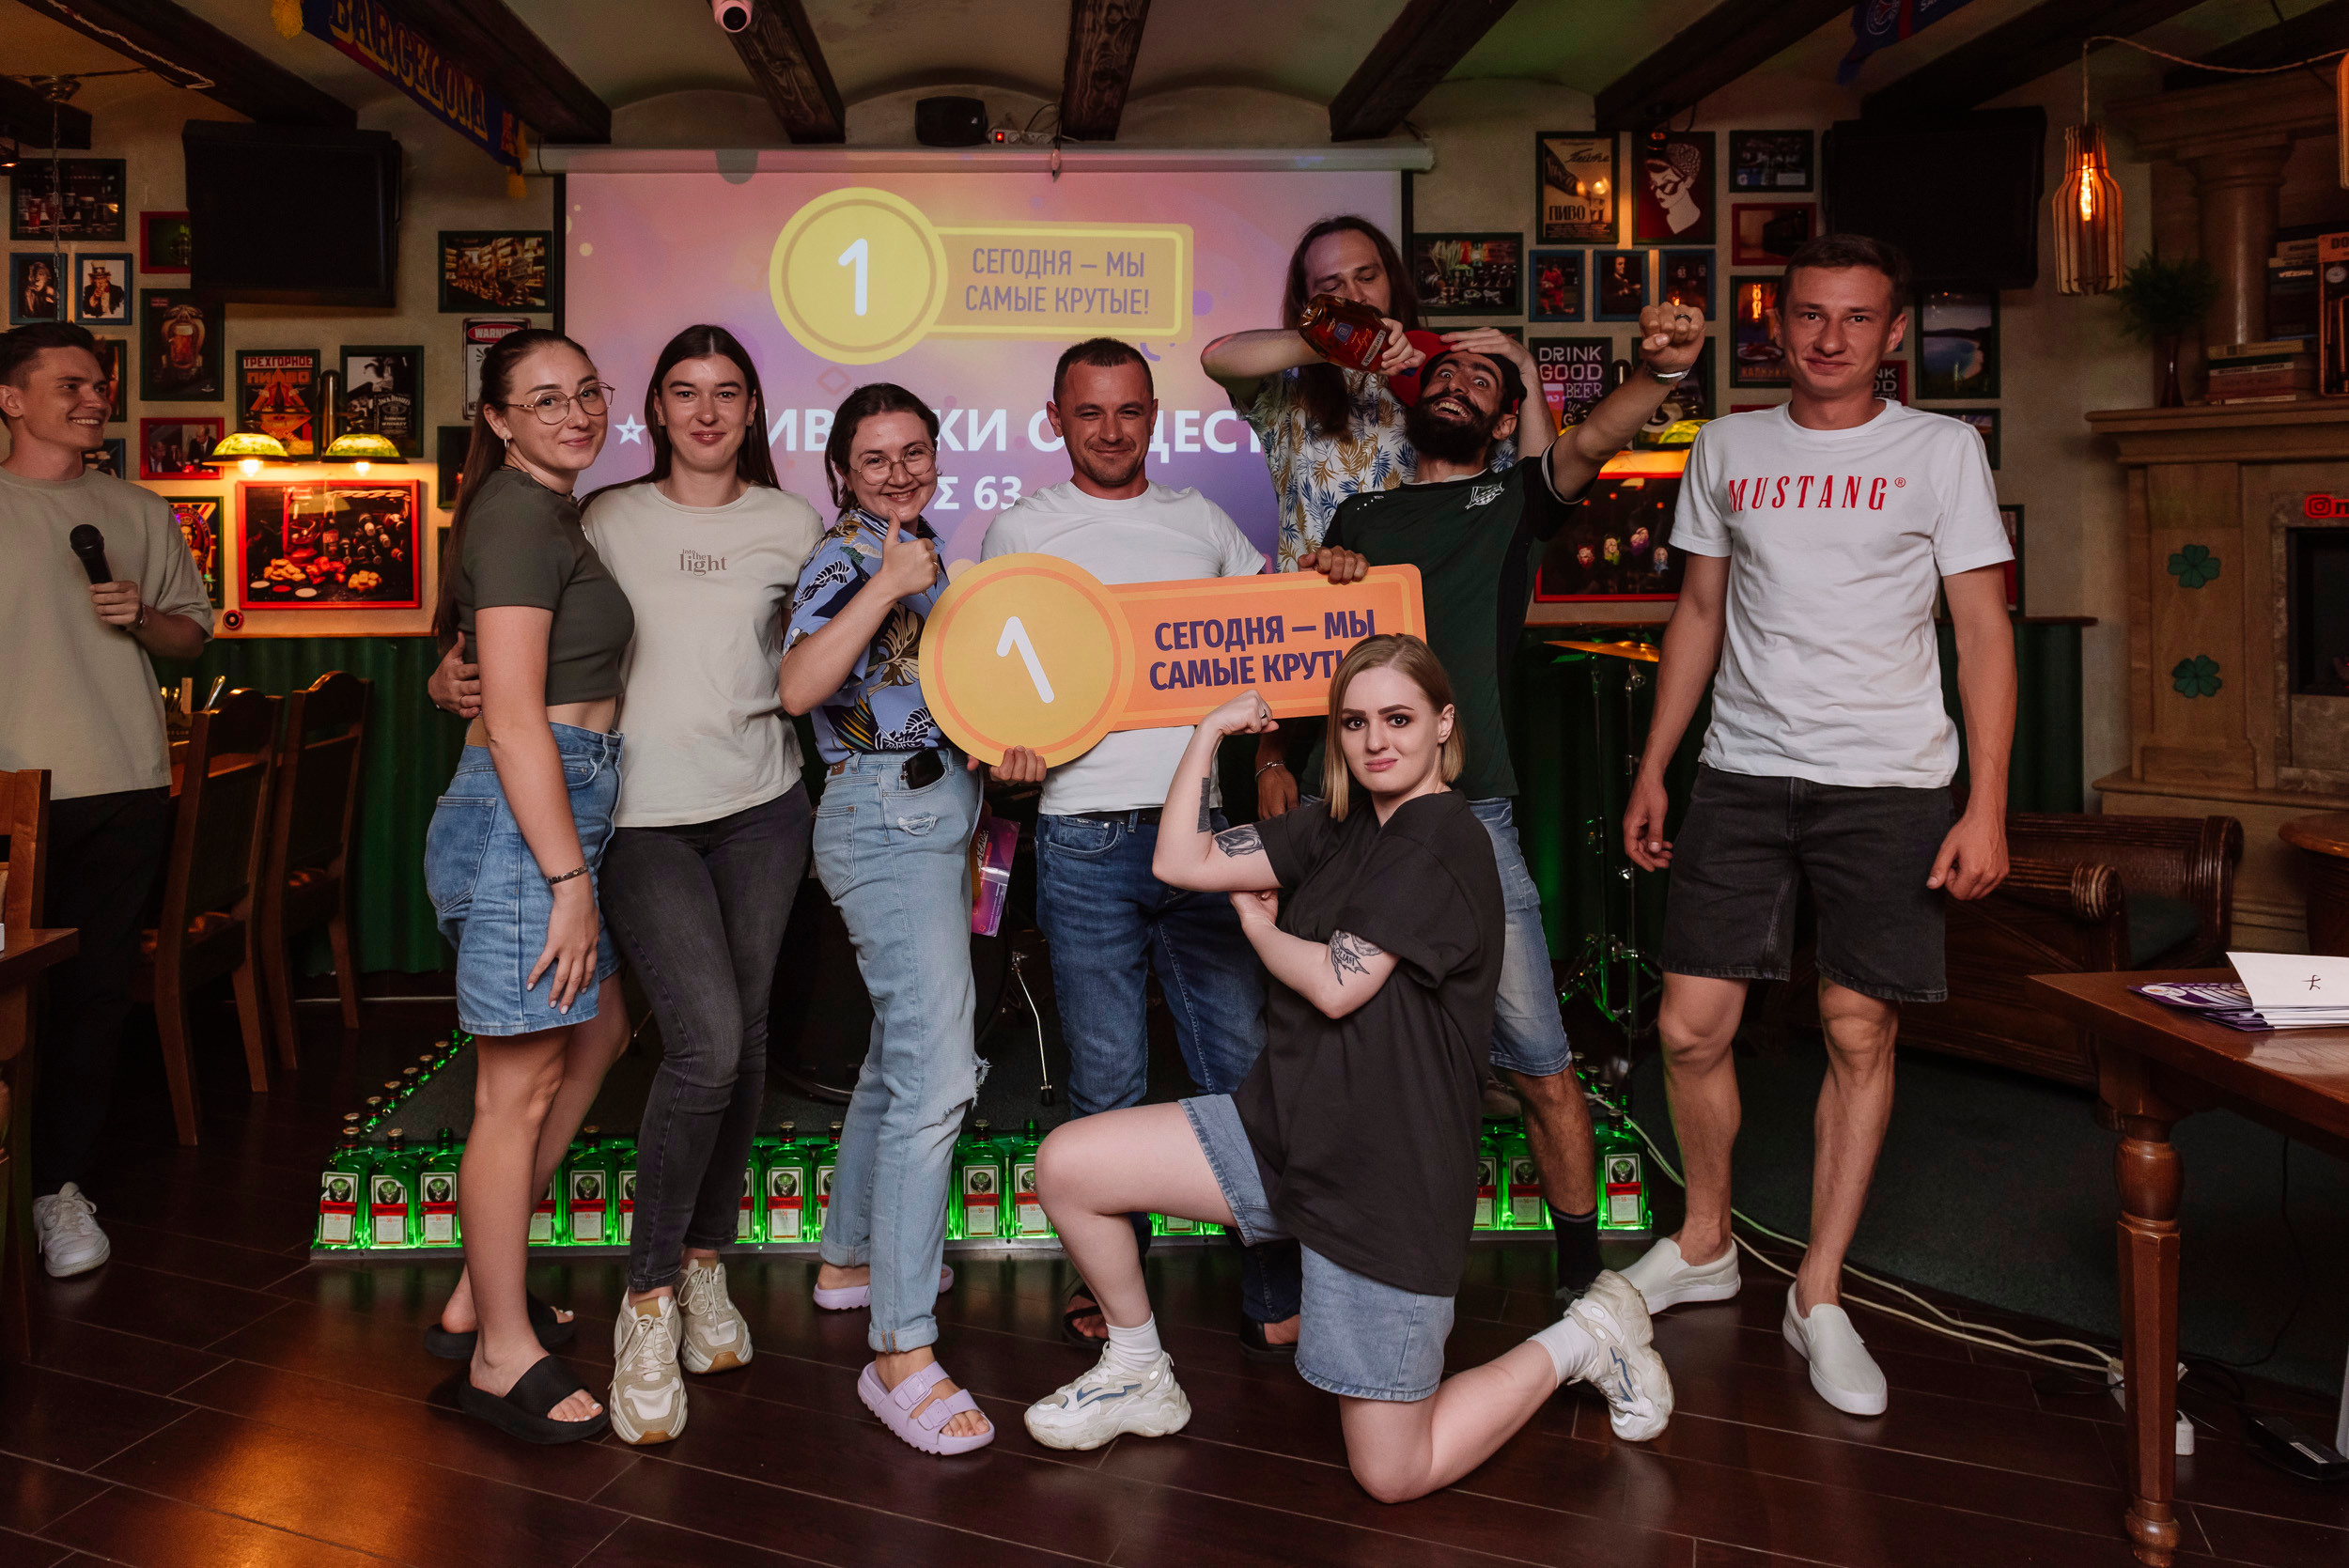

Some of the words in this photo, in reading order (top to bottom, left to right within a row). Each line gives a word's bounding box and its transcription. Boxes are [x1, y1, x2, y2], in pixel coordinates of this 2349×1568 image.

[329, 0, 489, 142] BARCELONA
[1548, 205, 1586, 222] ПИВО
[838, 237, 867, 317] 1
[972, 247, 1071, 281] СЕГОДНЯ
[1106, 251, 1144, 279] МЫ
[965, 285, 1047, 313] САМЫЕ
[1054, 287, 1148, 315] КРУТЫЕ!
[244, 356, 313, 368] ТРЕХГОРНОЕ
[1538, 346, 1602, 362] DRINK
[1539, 364, 1603, 381] GOOD
[1565, 382, 1603, 399] BEER
[679, 553, 728, 577] light
[1154, 614, 1284, 653] СЕГОДНЯ
[1324, 609, 1376, 640] МЫ
[996, 615, 1055, 704] 1
[1148, 654, 1256, 691] САМЫЕ
[1262, 649, 1346, 684] КРУТ
